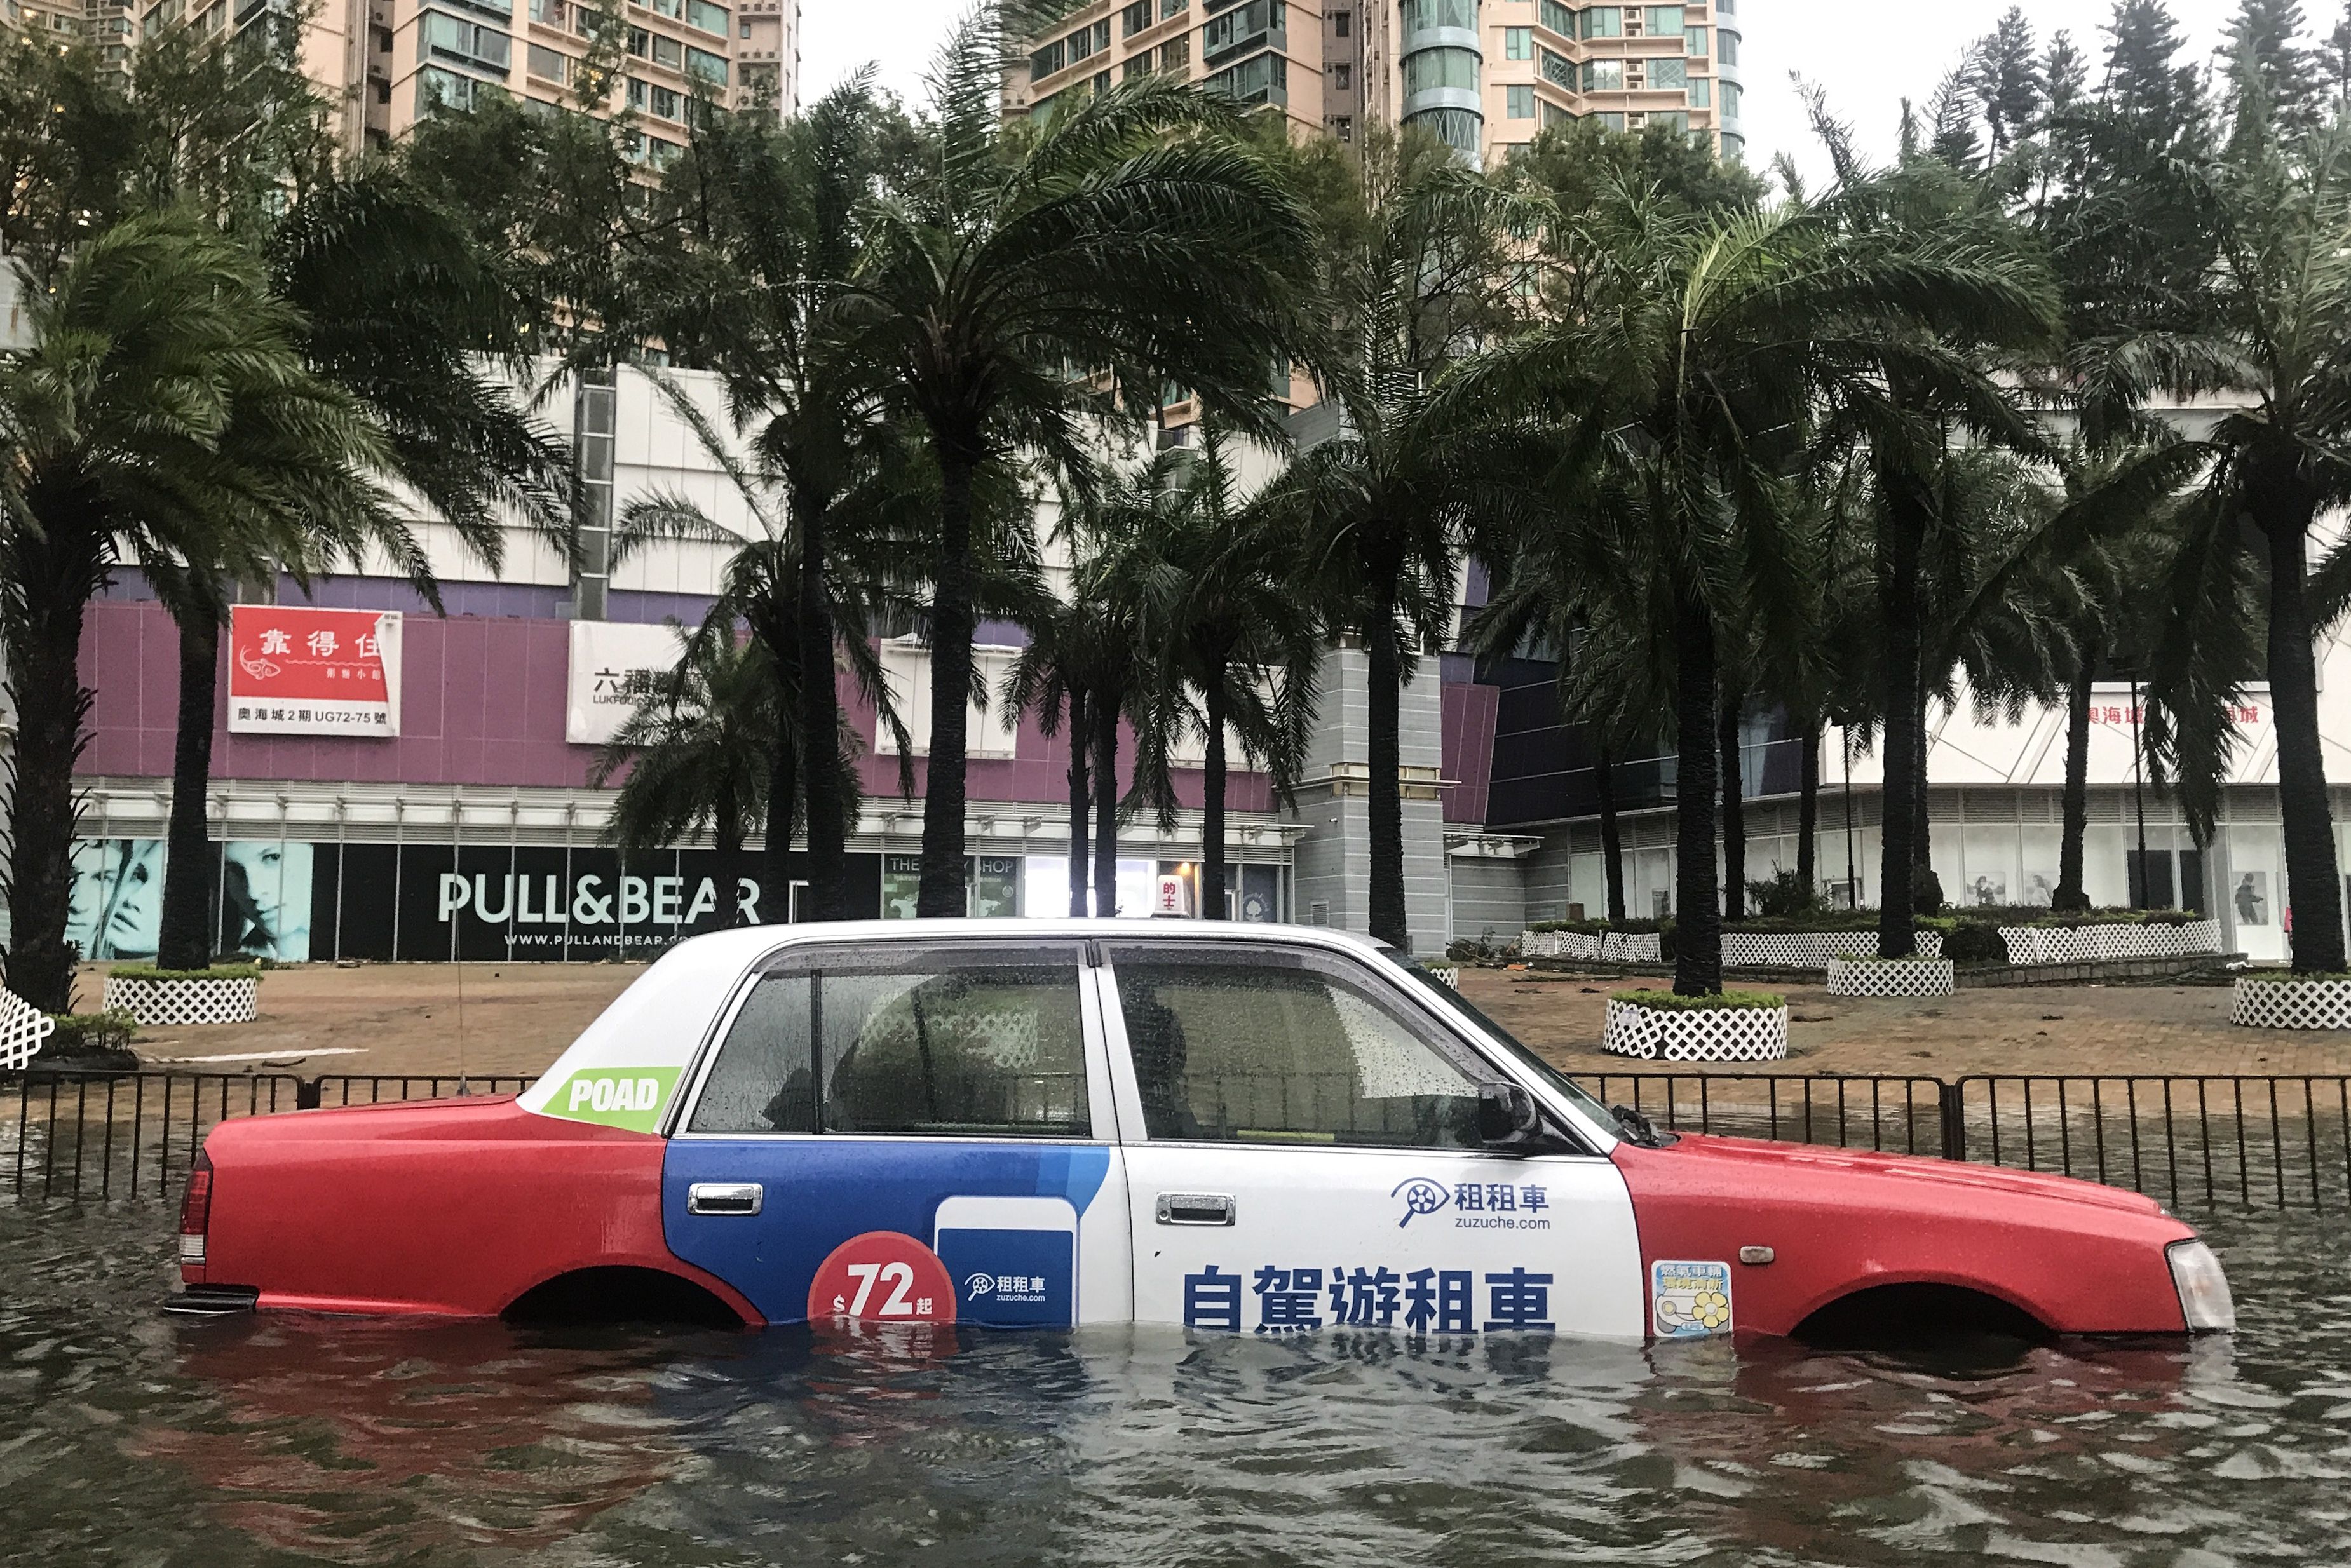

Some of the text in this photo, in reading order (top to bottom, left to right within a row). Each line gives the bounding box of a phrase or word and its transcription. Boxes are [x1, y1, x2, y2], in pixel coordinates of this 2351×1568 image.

[259, 628, 380, 658] 靠得住
[890, 858, 920, 871] THE
[976, 860, 1013, 873] HOP
[438, 874, 761, 924] PULL&BEAR
[1163, 882, 1176, 907] 的士
[568, 1078, 659, 1112] POAD
[1454, 1183, 1549, 1213] 租租車
[1454, 1216, 1550, 1230] zuzuche.com
[996, 1276, 1045, 1294] 租租車
[1184, 1264, 1557, 1334] 自駕遊租車
